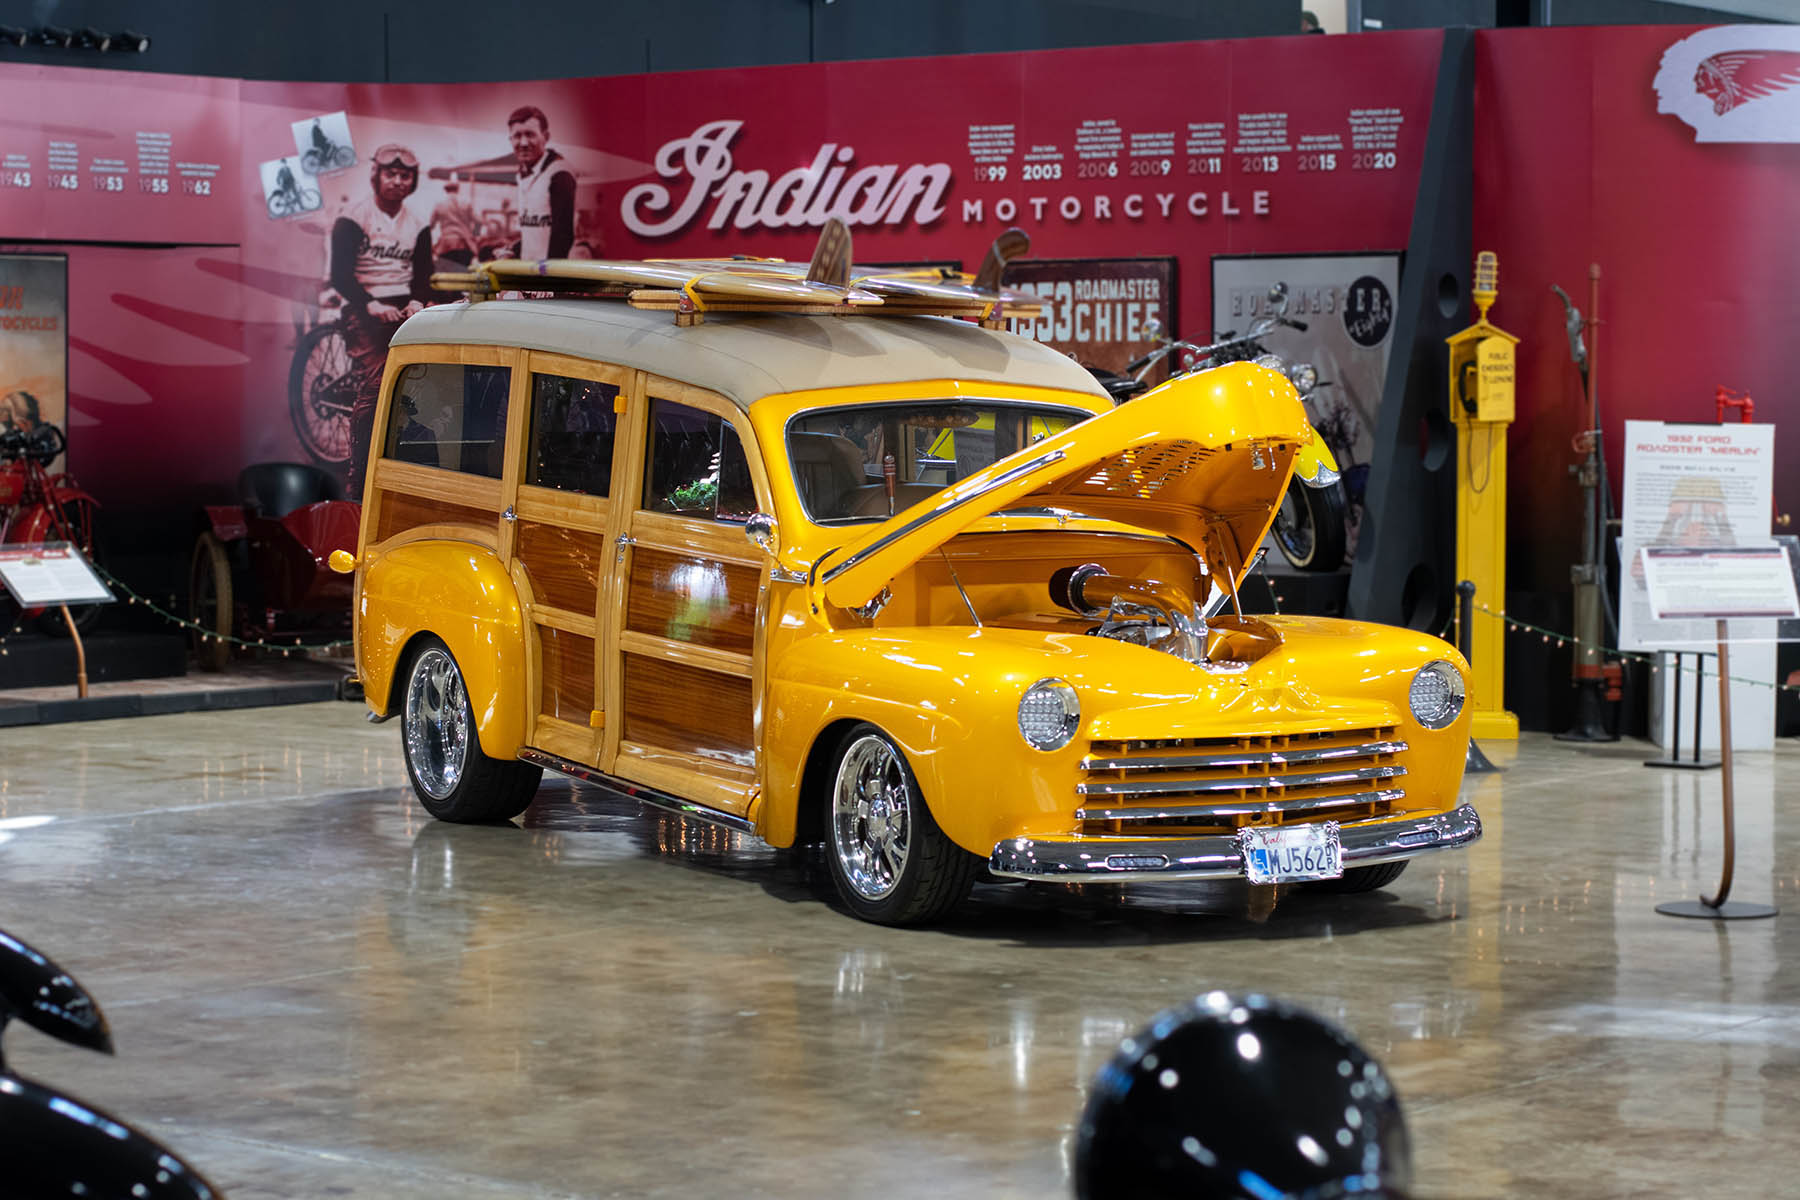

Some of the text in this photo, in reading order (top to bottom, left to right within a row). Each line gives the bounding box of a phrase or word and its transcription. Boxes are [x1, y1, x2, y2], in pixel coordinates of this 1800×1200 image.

[1078, 161, 1119, 178] 2006
[1130, 159, 1171, 177] 2009
[1188, 158, 1222, 174] 2011
[1242, 156, 1279, 172] 2013
[1298, 154, 1337, 171] 2015
[1352, 152, 1397, 170] 2020
[620, 119, 952, 237] Indian
[974, 165, 1007, 181] 1999
[1022, 163, 1062, 180] 2003
[48, 174, 78, 190] 1945
[94, 176, 124, 191] 1953
[139, 178, 170, 193] 1955
[182, 180, 211, 195] 1962
[962, 190, 1270, 223] MOTORCYCLE
[359, 233, 413, 260] India
[1074, 279, 1161, 300] ROADMASTER
[1232, 286, 1381, 317] ROAMASTER
[1697, 435, 1732, 444] FORD
[1636, 443, 1703, 454] ROADSTER
[1267, 846, 1326, 875] MJ562
